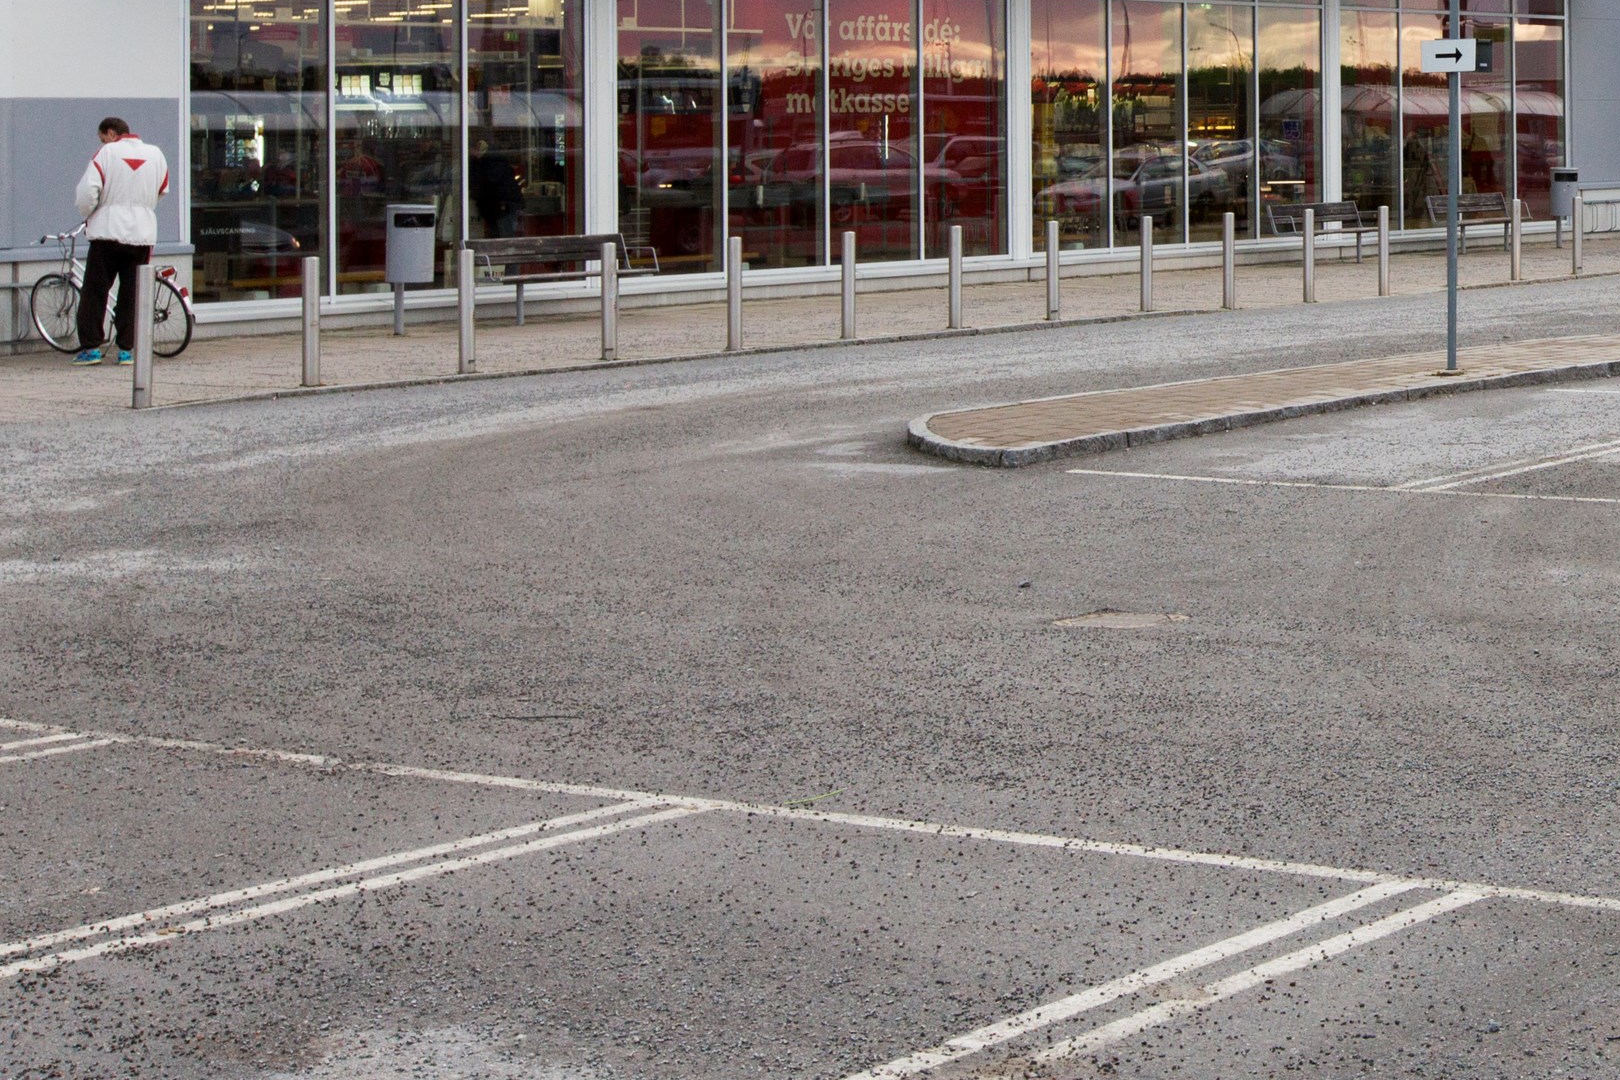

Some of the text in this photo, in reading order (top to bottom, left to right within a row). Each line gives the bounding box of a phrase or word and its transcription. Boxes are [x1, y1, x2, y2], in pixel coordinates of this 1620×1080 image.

[785, 11, 961, 43] Vå affärsdé:
[785, 51, 895, 83] Svriges
[785, 88, 910, 114] mtkasse
